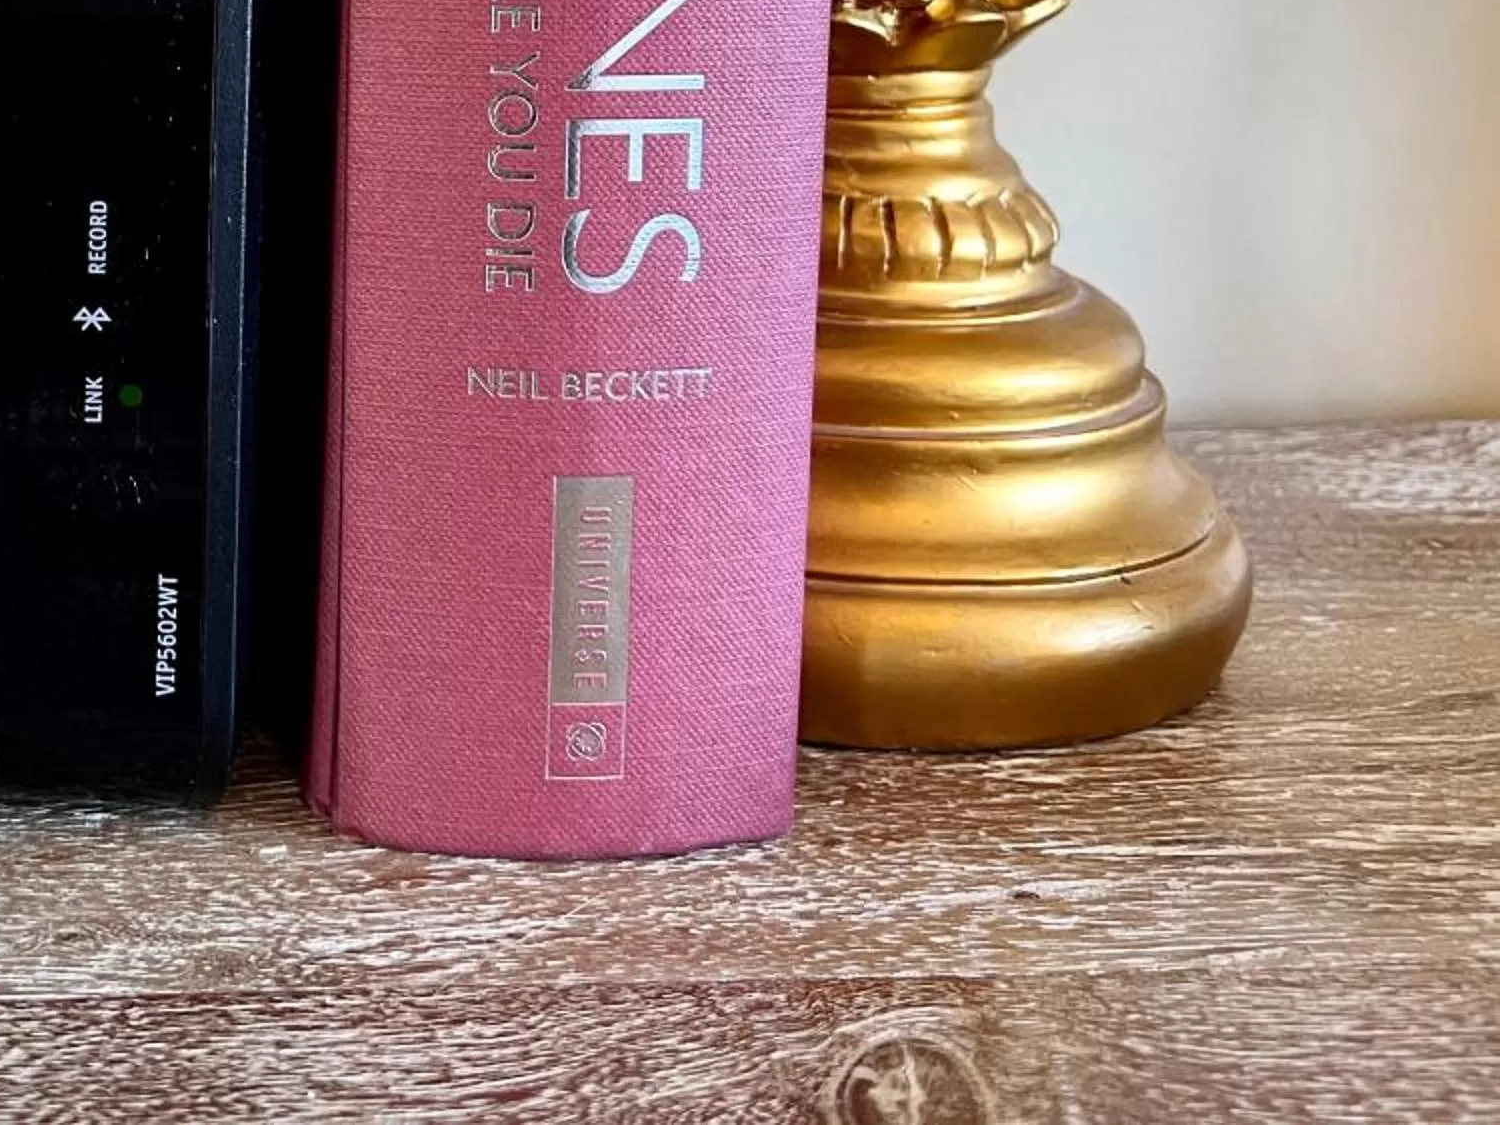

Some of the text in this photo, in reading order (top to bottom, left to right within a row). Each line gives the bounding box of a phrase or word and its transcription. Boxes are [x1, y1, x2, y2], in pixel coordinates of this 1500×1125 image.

[486, 51, 541, 183] YOU
[88, 199, 109, 275] RECORD
[484, 202, 538, 293] DIE
[85, 376, 103, 424] LINK
[467, 366, 714, 402] NEIL BECKETT
[155, 574, 178, 697] VIP5602WT
[573, 505, 613, 690] UNIVERSE
